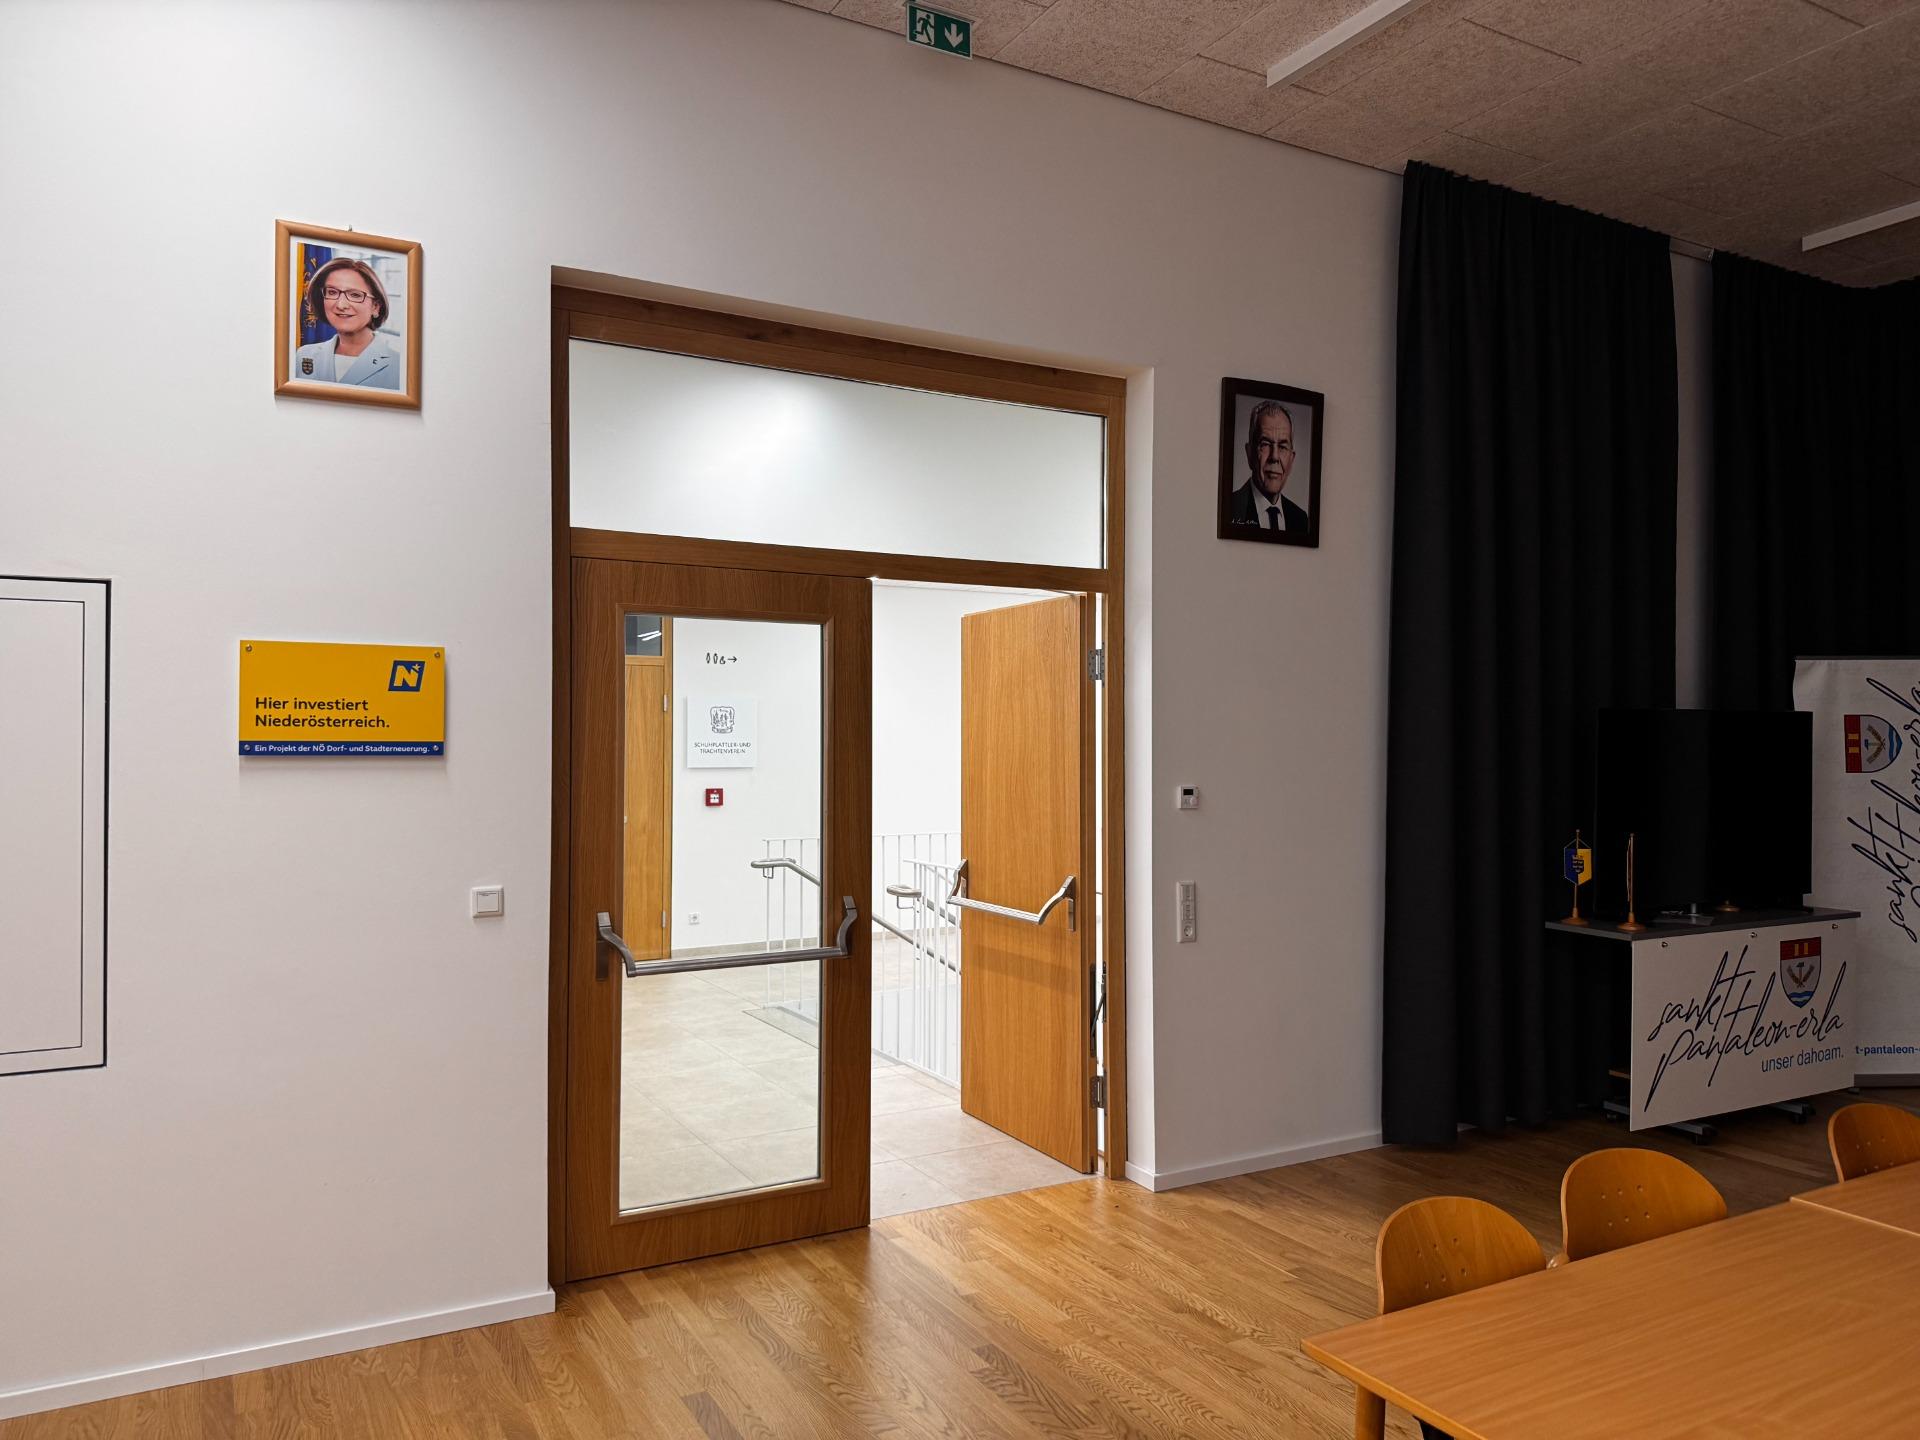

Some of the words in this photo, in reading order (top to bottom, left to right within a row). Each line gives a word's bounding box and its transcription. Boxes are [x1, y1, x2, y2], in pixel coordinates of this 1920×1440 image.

[255, 697, 289, 710] Hier
[293, 697, 369, 711] investiert
[255, 714, 391, 728] Niederösterreich.
[254, 744, 267, 752] Ein
[268, 744, 297, 754] Projekt
[298, 744, 311, 752] der
[312, 743, 326, 752] NÖ
[326, 744, 348, 752] Dorf-
[348, 744, 364, 752] und
[364, 744, 430, 754] Stadterneuerung.
[1647, 945, 1756, 1042] sankt
[1855, 1044, 1920, 1057] t-pantaleon-
[1761, 1055, 1794, 1073] unser
[1797, 1046, 1844, 1066] dahoam.
